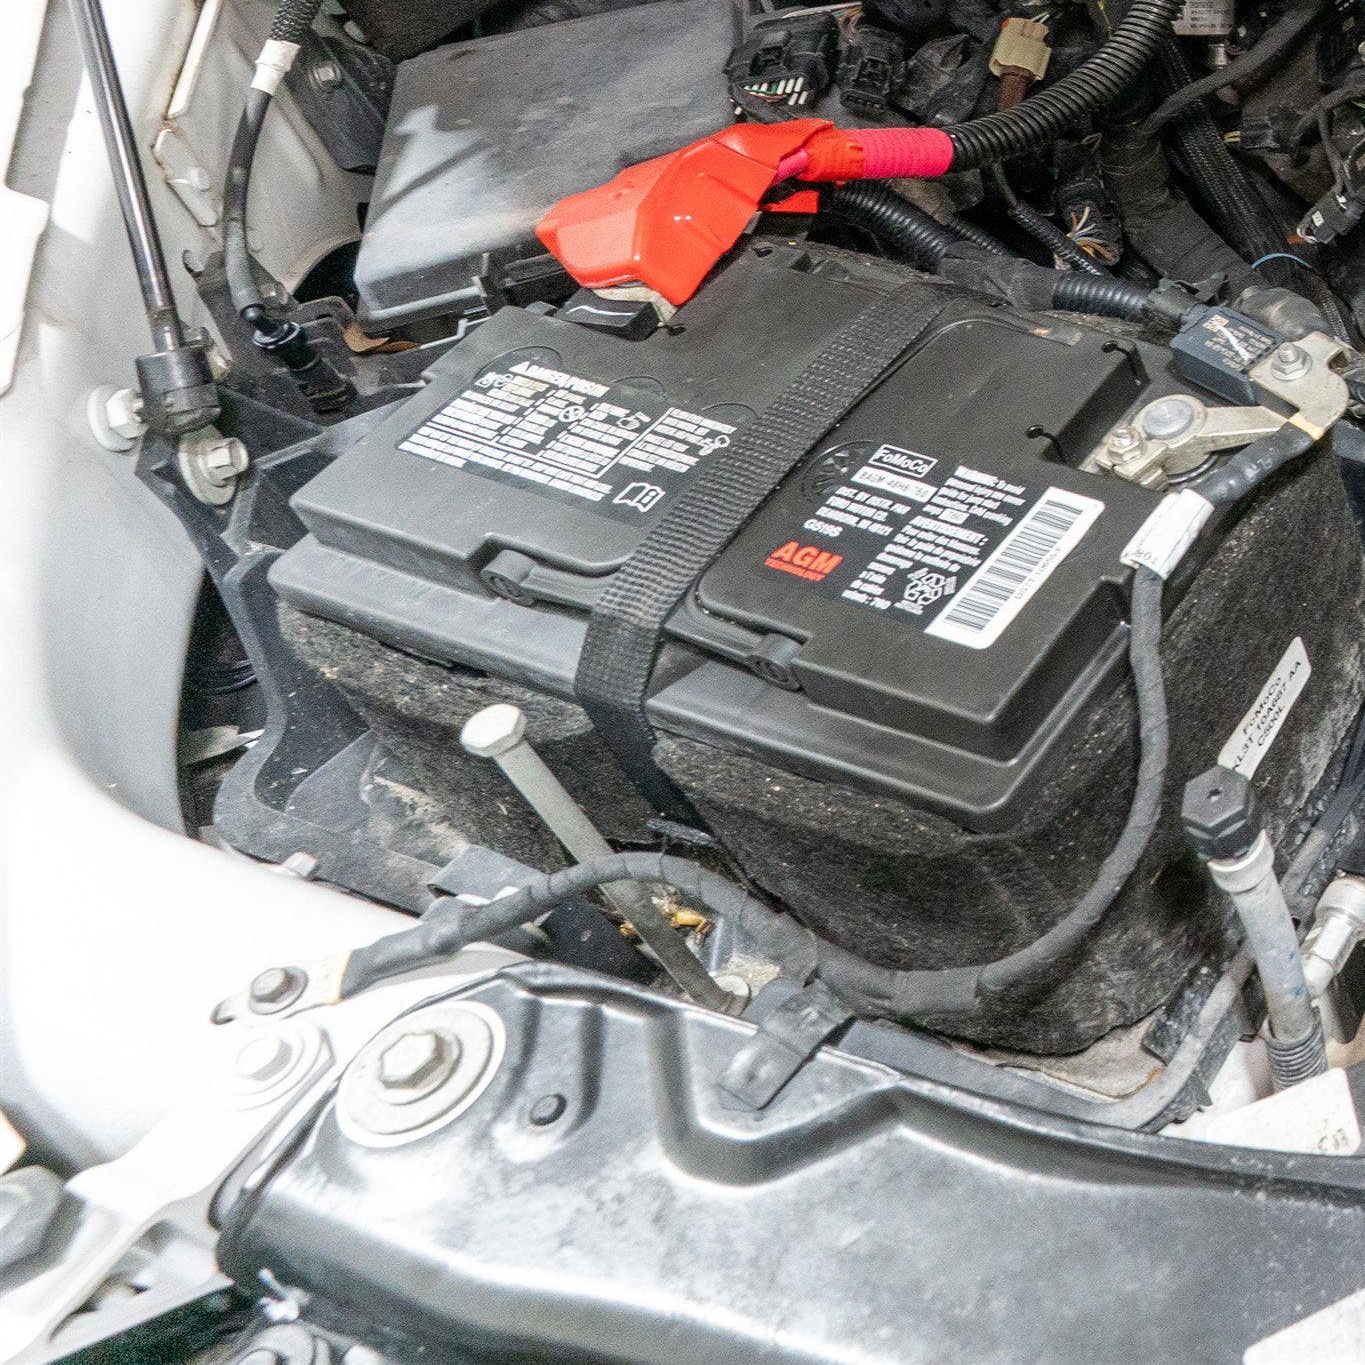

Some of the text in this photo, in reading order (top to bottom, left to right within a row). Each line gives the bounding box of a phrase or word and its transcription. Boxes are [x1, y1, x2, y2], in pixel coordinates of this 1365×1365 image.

[874, 449, 931, 472] FoMoCo
[770, 540, 843, 575] AGM
[1243, 677, 1282, 735] FoMoCo
